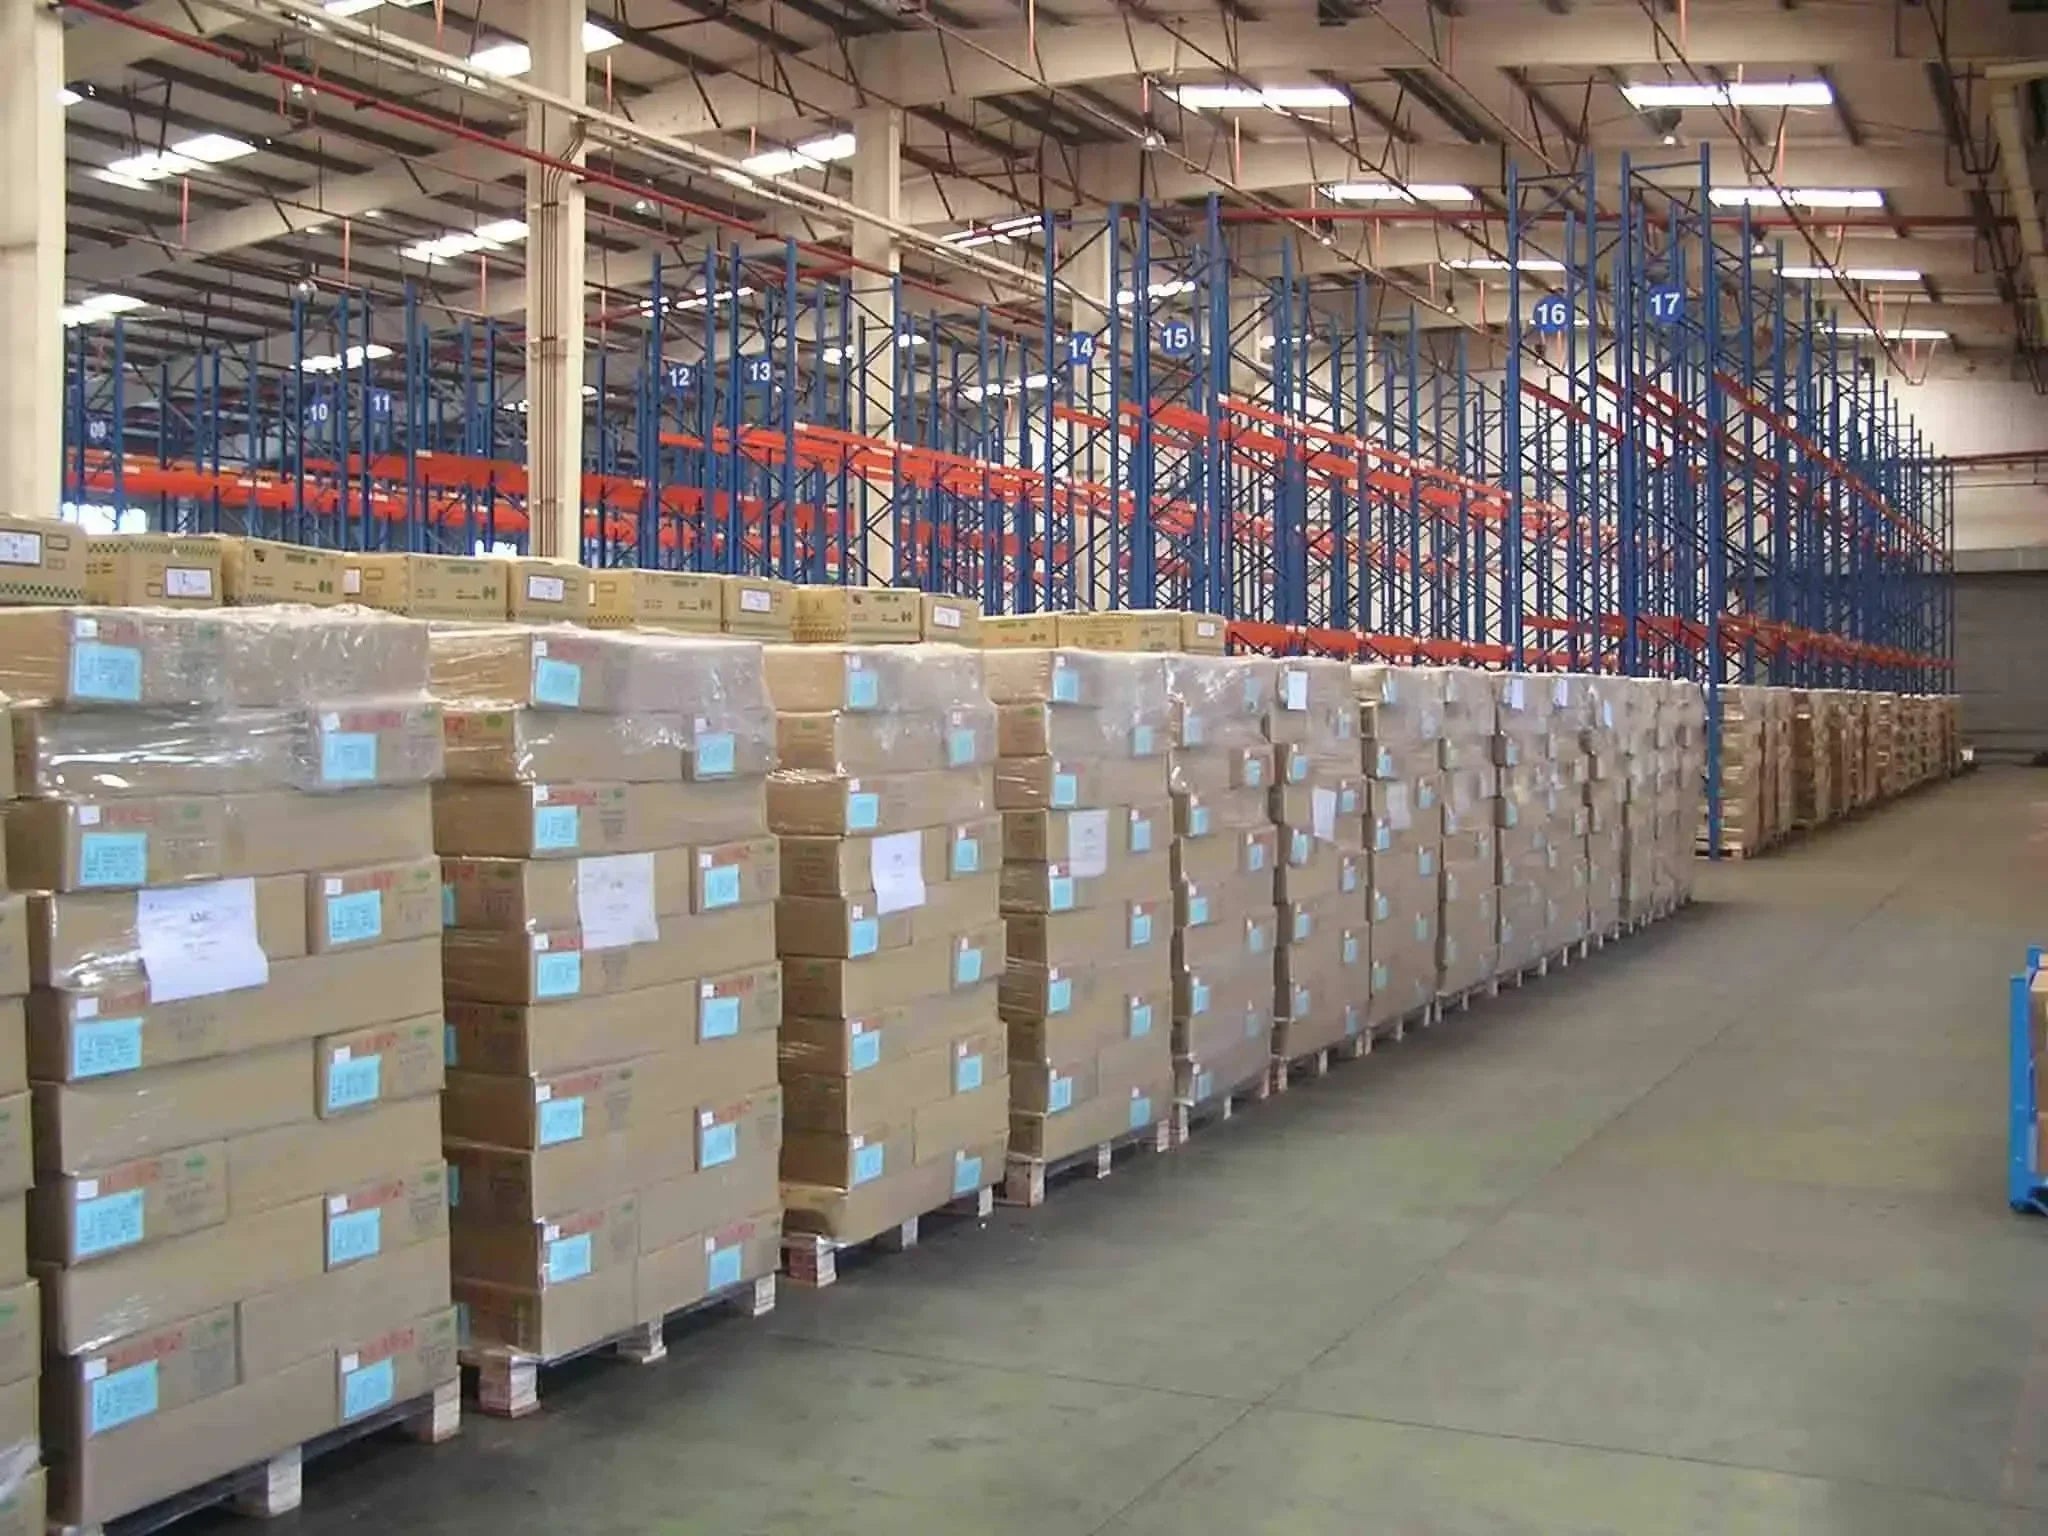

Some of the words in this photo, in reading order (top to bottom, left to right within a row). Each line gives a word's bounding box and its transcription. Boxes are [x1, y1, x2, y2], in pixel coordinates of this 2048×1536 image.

[1537, 303, 1566, 325] 16
[1651, 293, 1680, 315] 17
[1069, 337, 1094, 358] 14
[1163, 327, 1187, 349] 15
[669, 368, 690, 387] 12
[751, 362, 770, 381] 13
[310, 402, 329, 420] 10
[373, 394, 391, 412] 11
